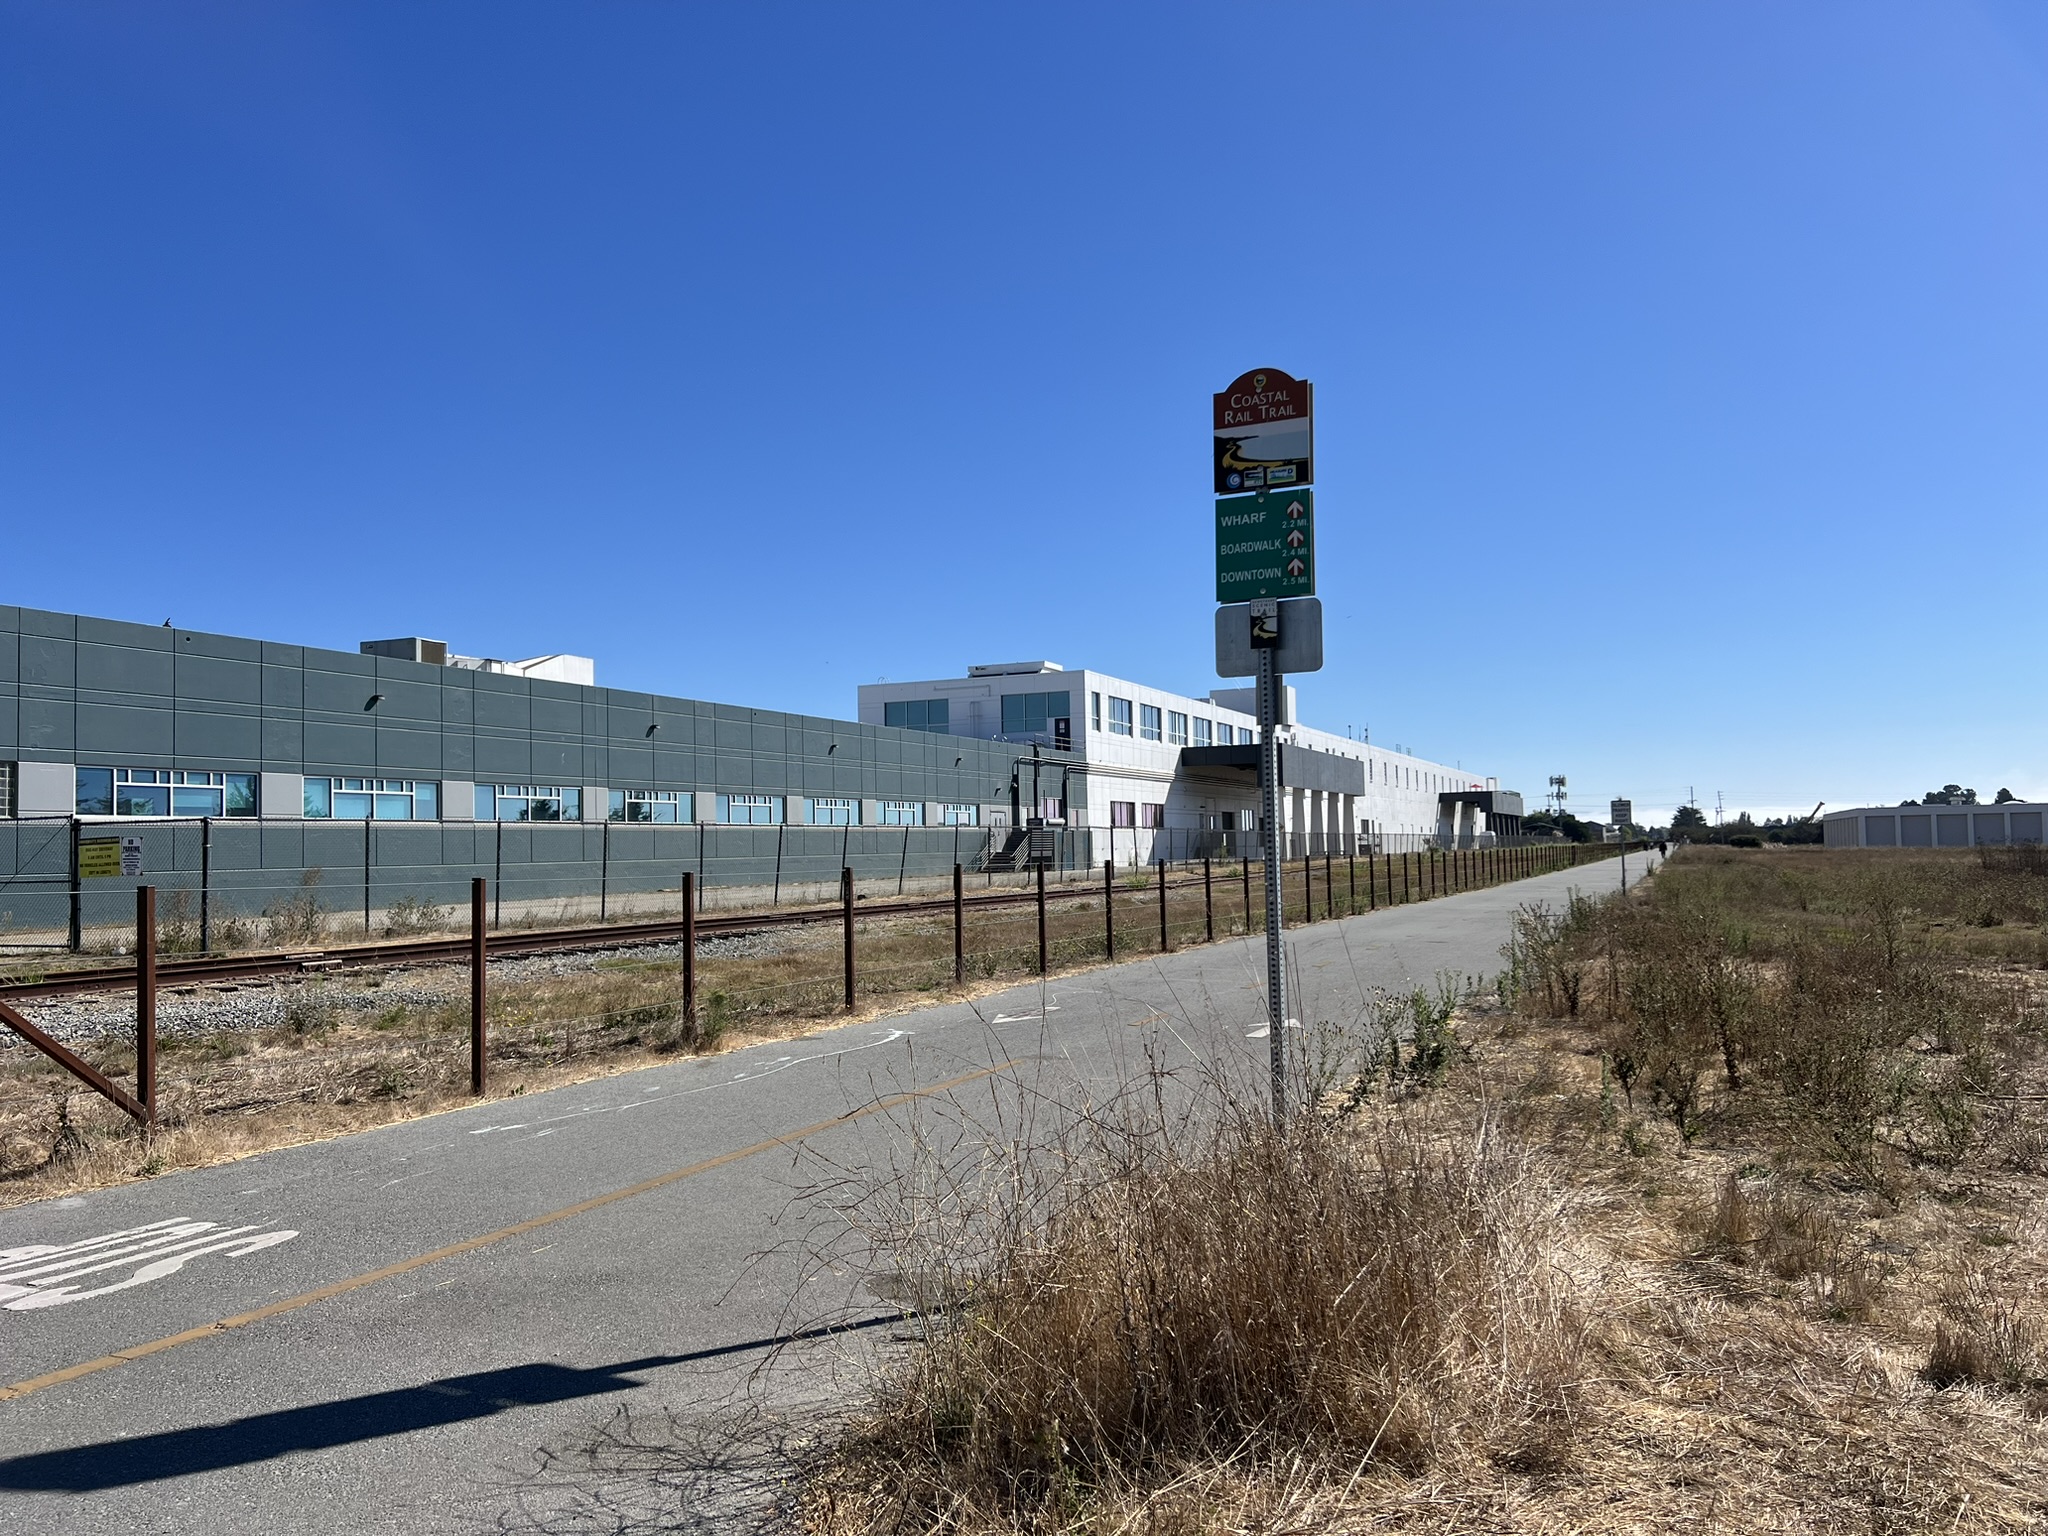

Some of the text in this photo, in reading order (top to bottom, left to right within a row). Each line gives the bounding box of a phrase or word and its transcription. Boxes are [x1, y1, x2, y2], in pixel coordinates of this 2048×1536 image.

[1231, 390, 1290, 408] COASTAL
[1224, 405, 1296, 425] RAIL TRAIL
[1220, 512, 1267, 527] WHARF
[1281, 519, 1309, 529] 2.2 MI.
[1220, 538, 1281, 555] BOARDWALK
[1282, 547, 1309, 557] 2.4 MI.
[1221, 567, 1281, 583] DOWNTOWN
[1282, 576, 1310, 585] 2.5 MI.
